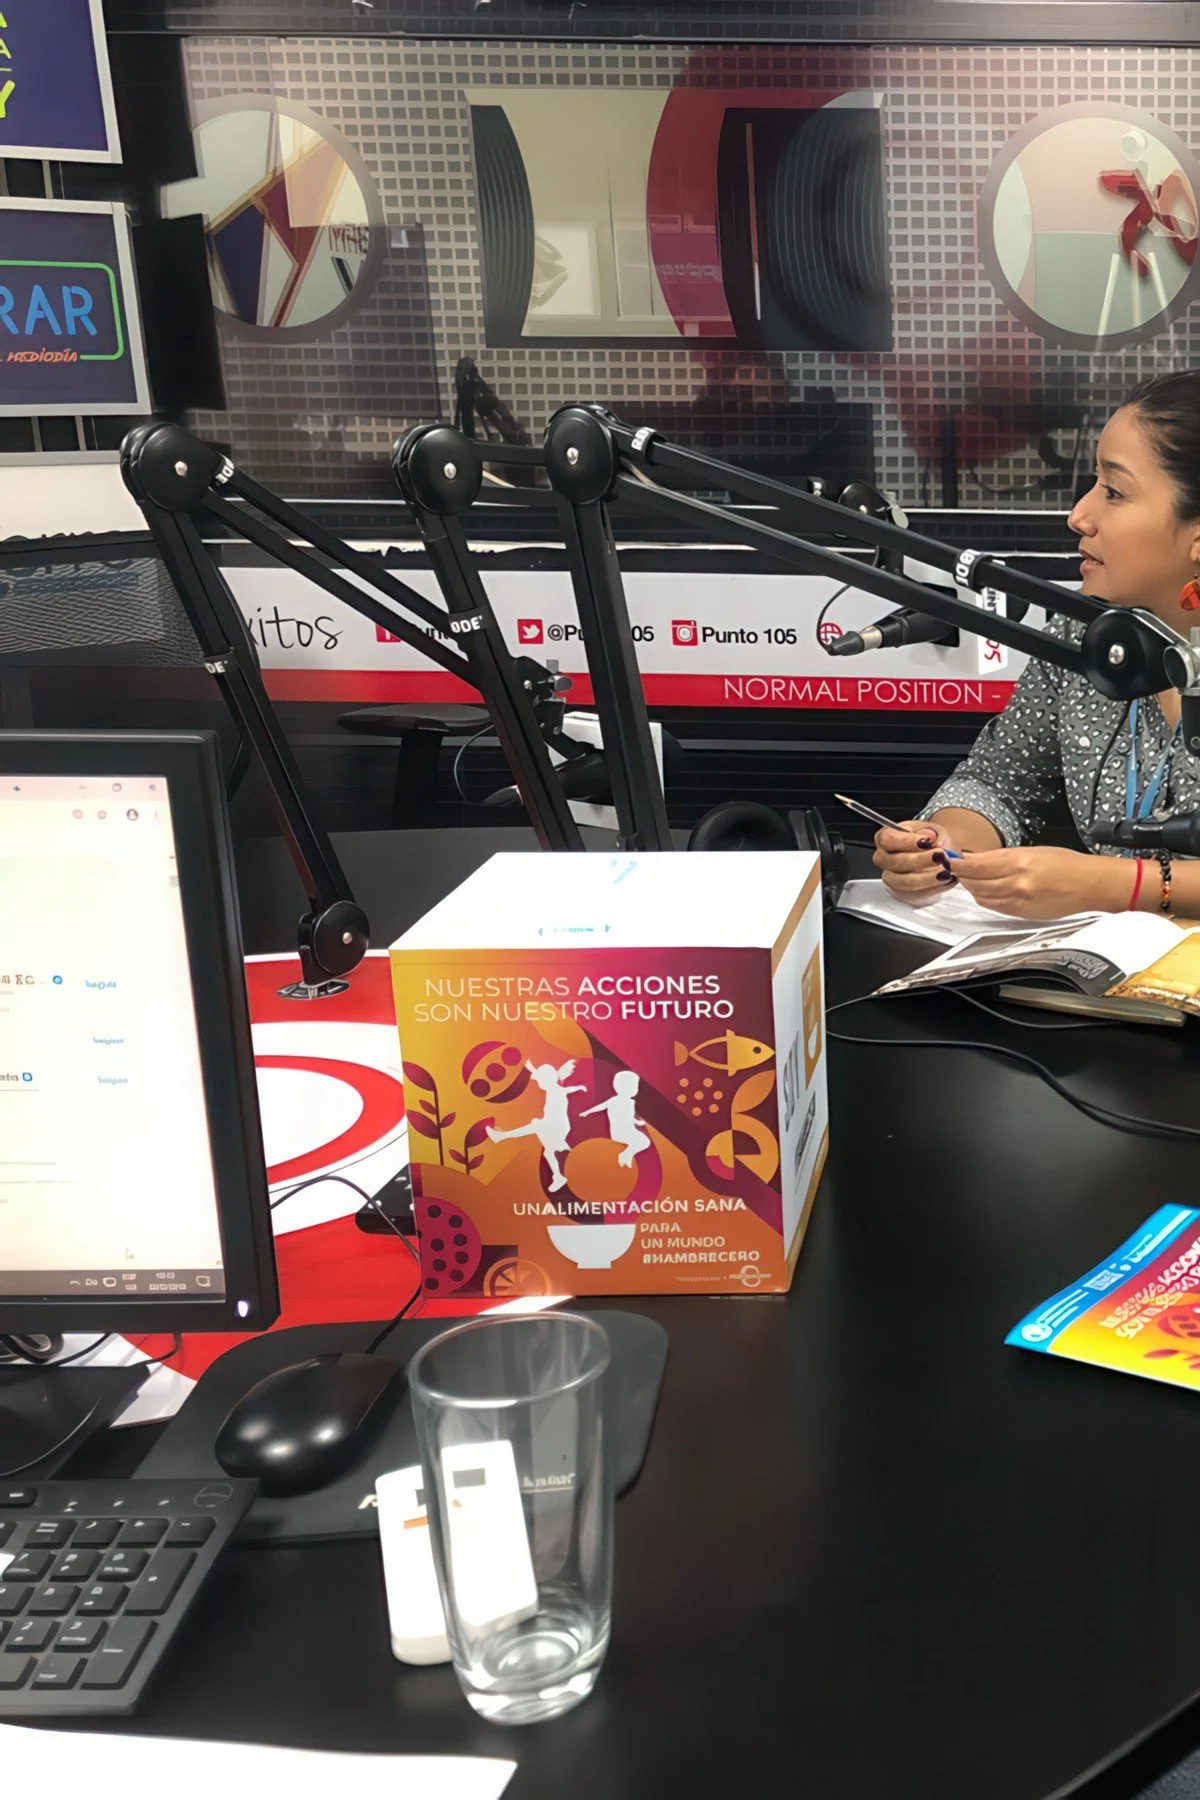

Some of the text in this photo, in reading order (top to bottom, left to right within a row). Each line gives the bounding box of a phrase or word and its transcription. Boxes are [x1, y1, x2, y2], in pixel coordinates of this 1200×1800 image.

[702, 626, 797, 645] Punto 105
[724, 677, 848, 703] NORMAL
[857, 680, 983, 705] POSITION
[424, 974, 721, 998] NUESTRAS ACCIONES
[414, 998, 735, 1022] SON NUESTRO FUTURO
[693, 1197, 748, 1213] SANA
[639, 1222, 682, 1234] PARA
[640, 1235, 726, 1249] UN MUNDO
